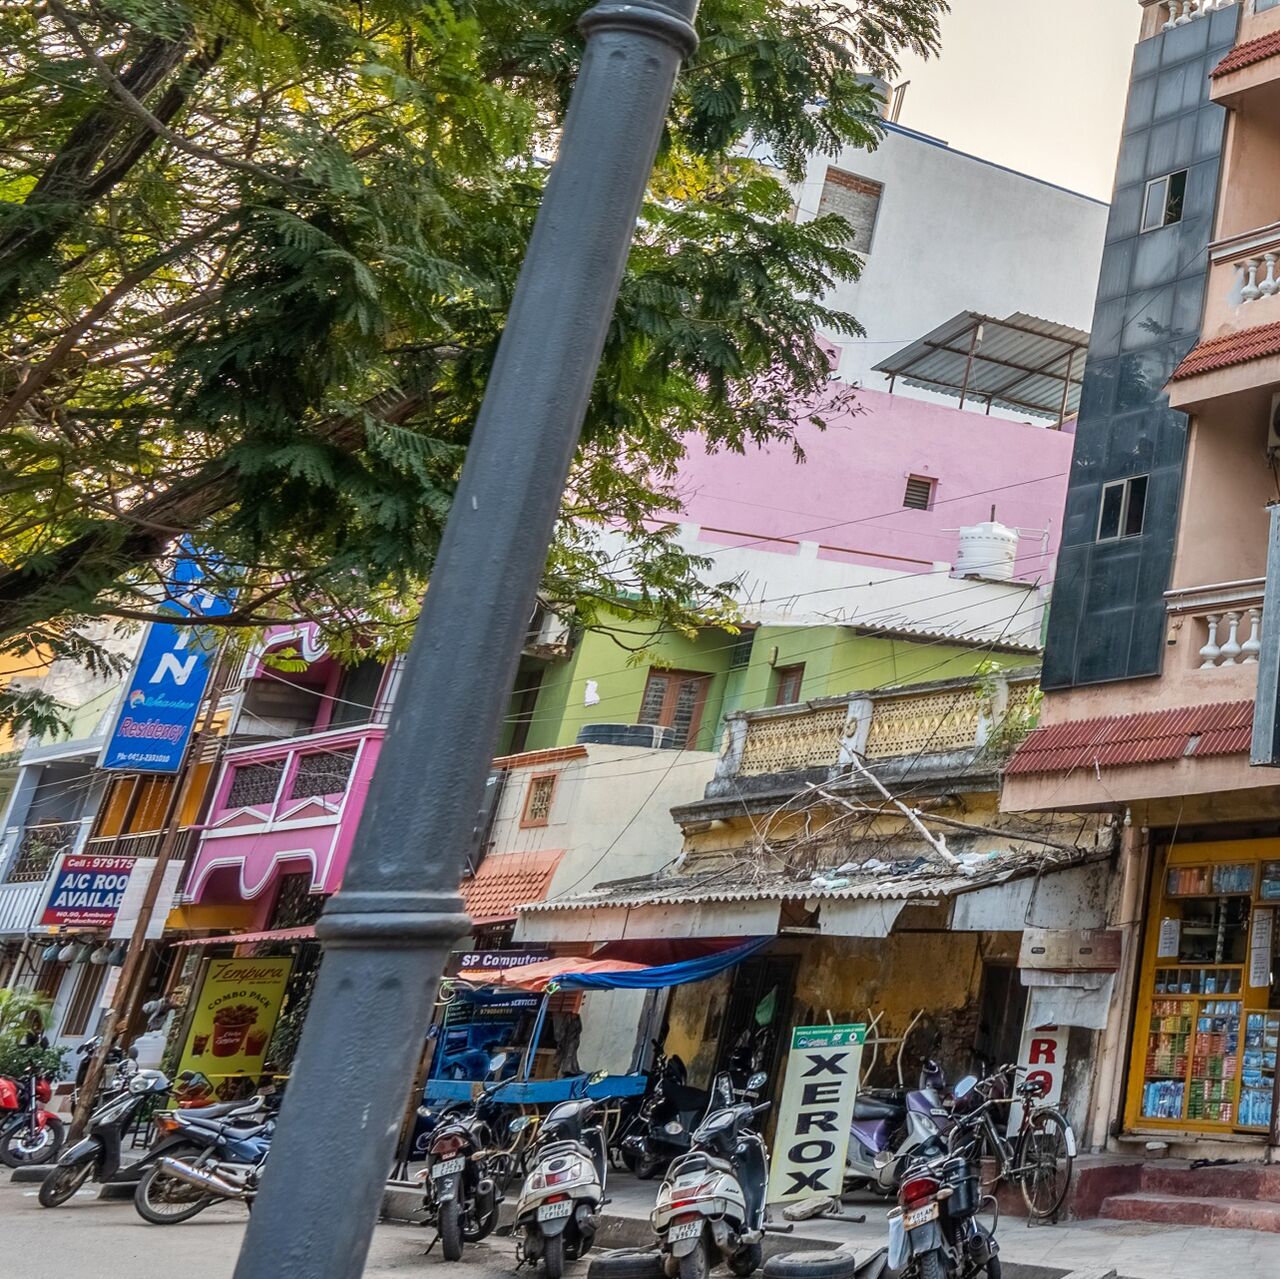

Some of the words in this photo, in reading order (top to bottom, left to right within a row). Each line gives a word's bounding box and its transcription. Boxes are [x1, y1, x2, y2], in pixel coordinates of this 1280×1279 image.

[117, 716, 187, 745] Residency
[68, 859, 85, 867] Cell
[60, 873, 90, 889] A/C
[462, 954, 480, 966] SP
[212, 963, 284, 984] Tempura
[207, 990, 247, 1011] COMBO
[249, 990, 271, 1008] PACK
[782, 1052, 850, 1195] XEROX
